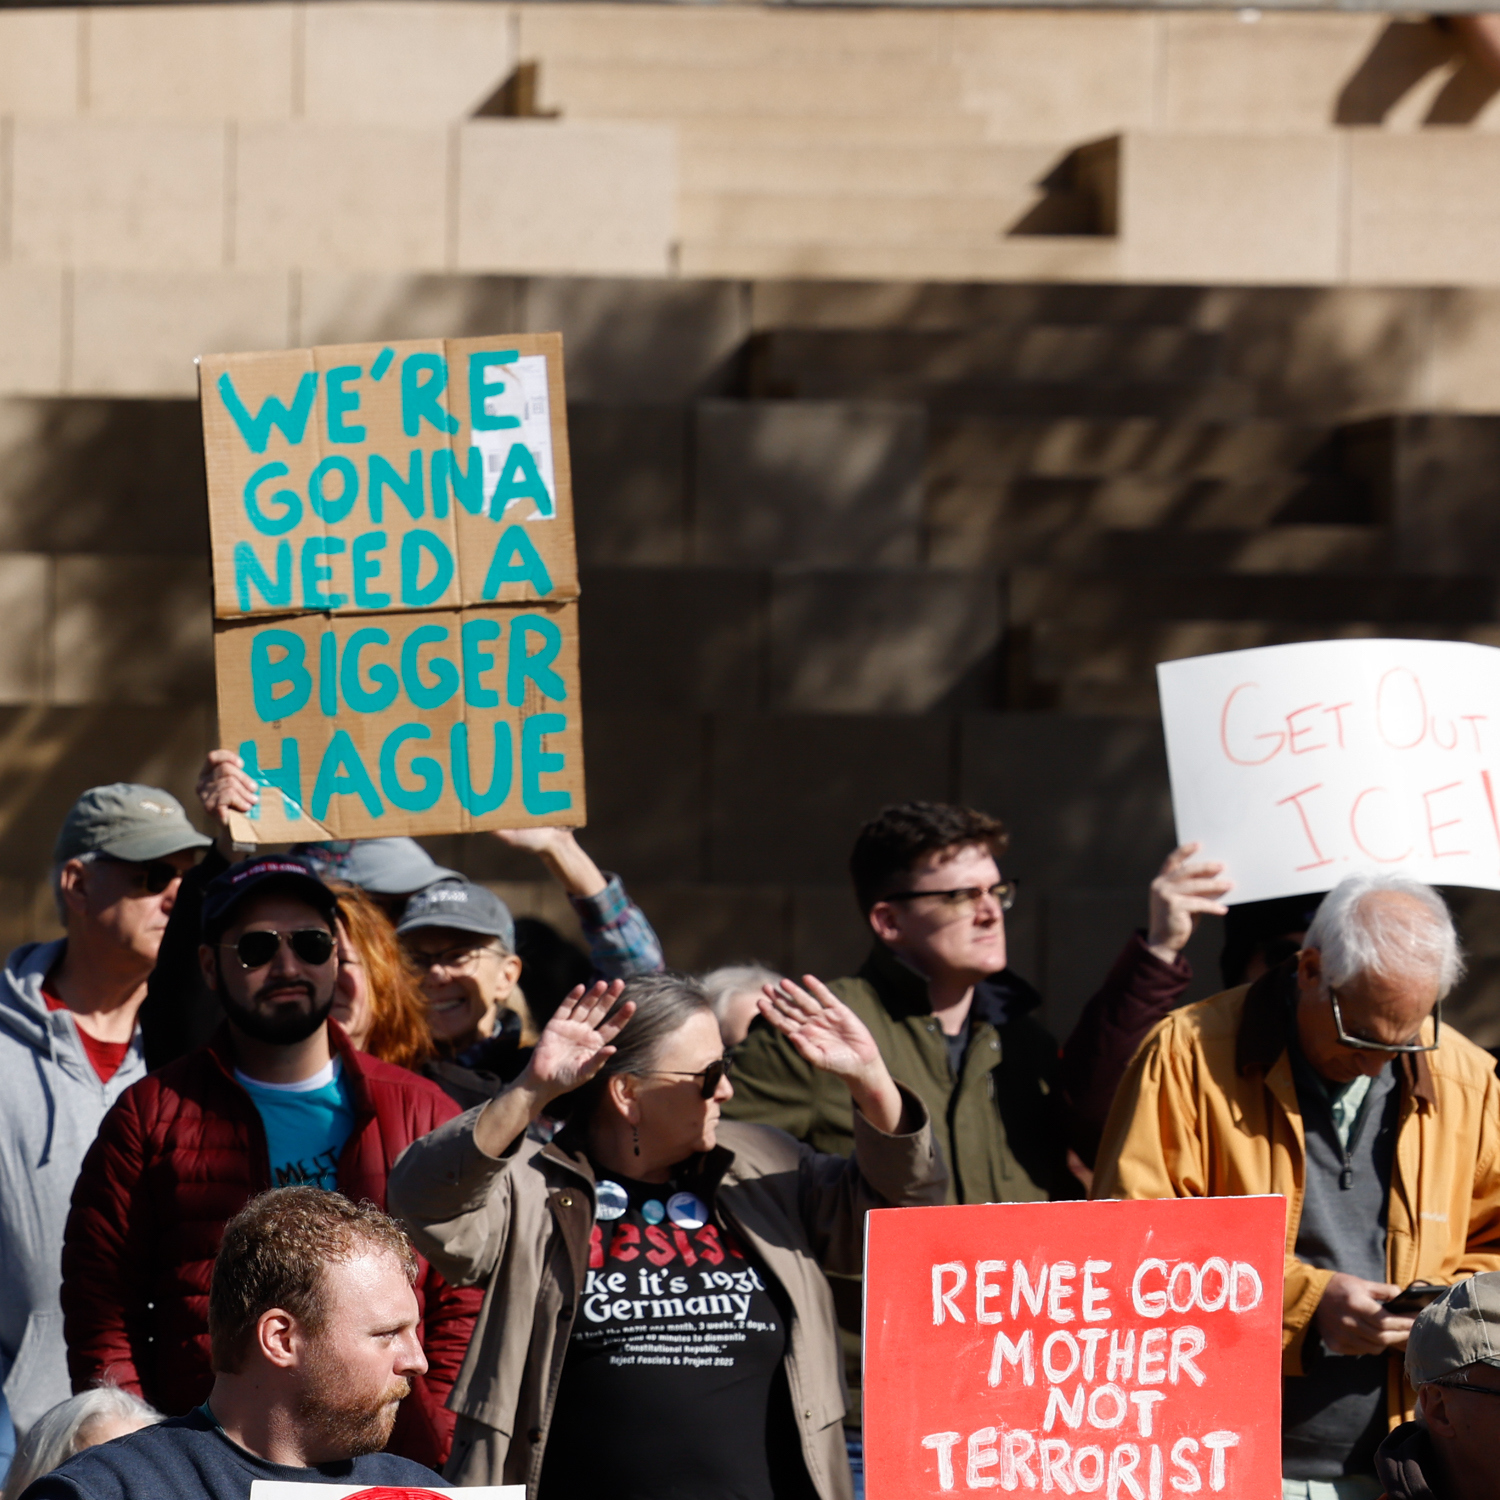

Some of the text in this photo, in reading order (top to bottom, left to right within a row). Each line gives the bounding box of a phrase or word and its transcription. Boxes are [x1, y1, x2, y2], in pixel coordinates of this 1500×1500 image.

[217, 347, 521, 454] WE'RE
[243, 443, 553, 536] GONNA
[233, 525, 553, 611] NEED A
[250, 614, 567, 722] BIGGER
[1220, 666, 1488, 766] GET OUT
[239, 713, 571, 821] HAGUE
[580, 1271, 627, 1295] ke
[639, 1268, 688, 1296] it's
[584, 1294, 751, 1322] Germany
[931, 1257, 1263, 1326] RENEE GOOD
[682, 1355, 713, 1368] Project
[987, 1325, 1206, 1387] MOTHER
[1043, 1383, 1167, 1438] NOT
